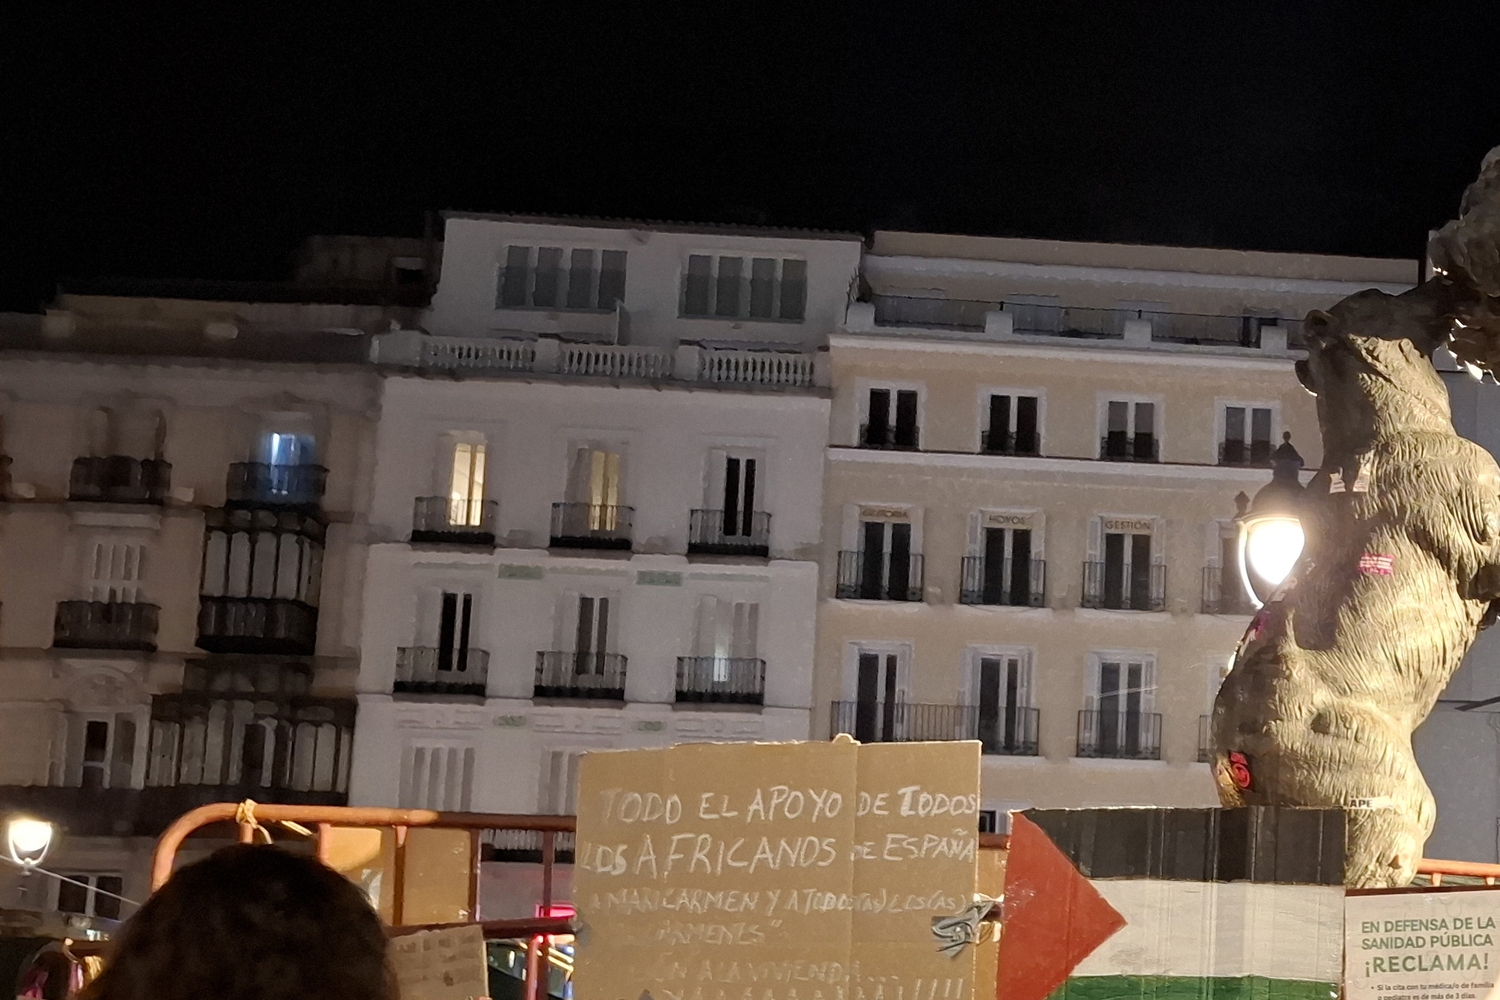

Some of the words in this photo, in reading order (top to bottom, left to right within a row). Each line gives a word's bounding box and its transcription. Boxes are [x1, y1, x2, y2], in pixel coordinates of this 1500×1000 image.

[600, 788, 683, 825] TODO
[698, 791, 738, 821] EL
[745, 785, 844, 824] APOYO
[857, 791, 889, 818] DE
[897, 785, 977, 818] TODOS
[882, 828, 975, 863] ESPAÑA
[1362, 921, 1380, 933] EN
[1384, 918, 1449, 933] DEFENSA
[1453, 918, 1473, 930] DE
[1477, 916, 1496, 930] LA
[1362, 935, 1426, 950] SANIDAD
[1430, 931, 1493, 949] PÚBLICA
[1365, 953, 1489, 977] ¡RECLAMA!
